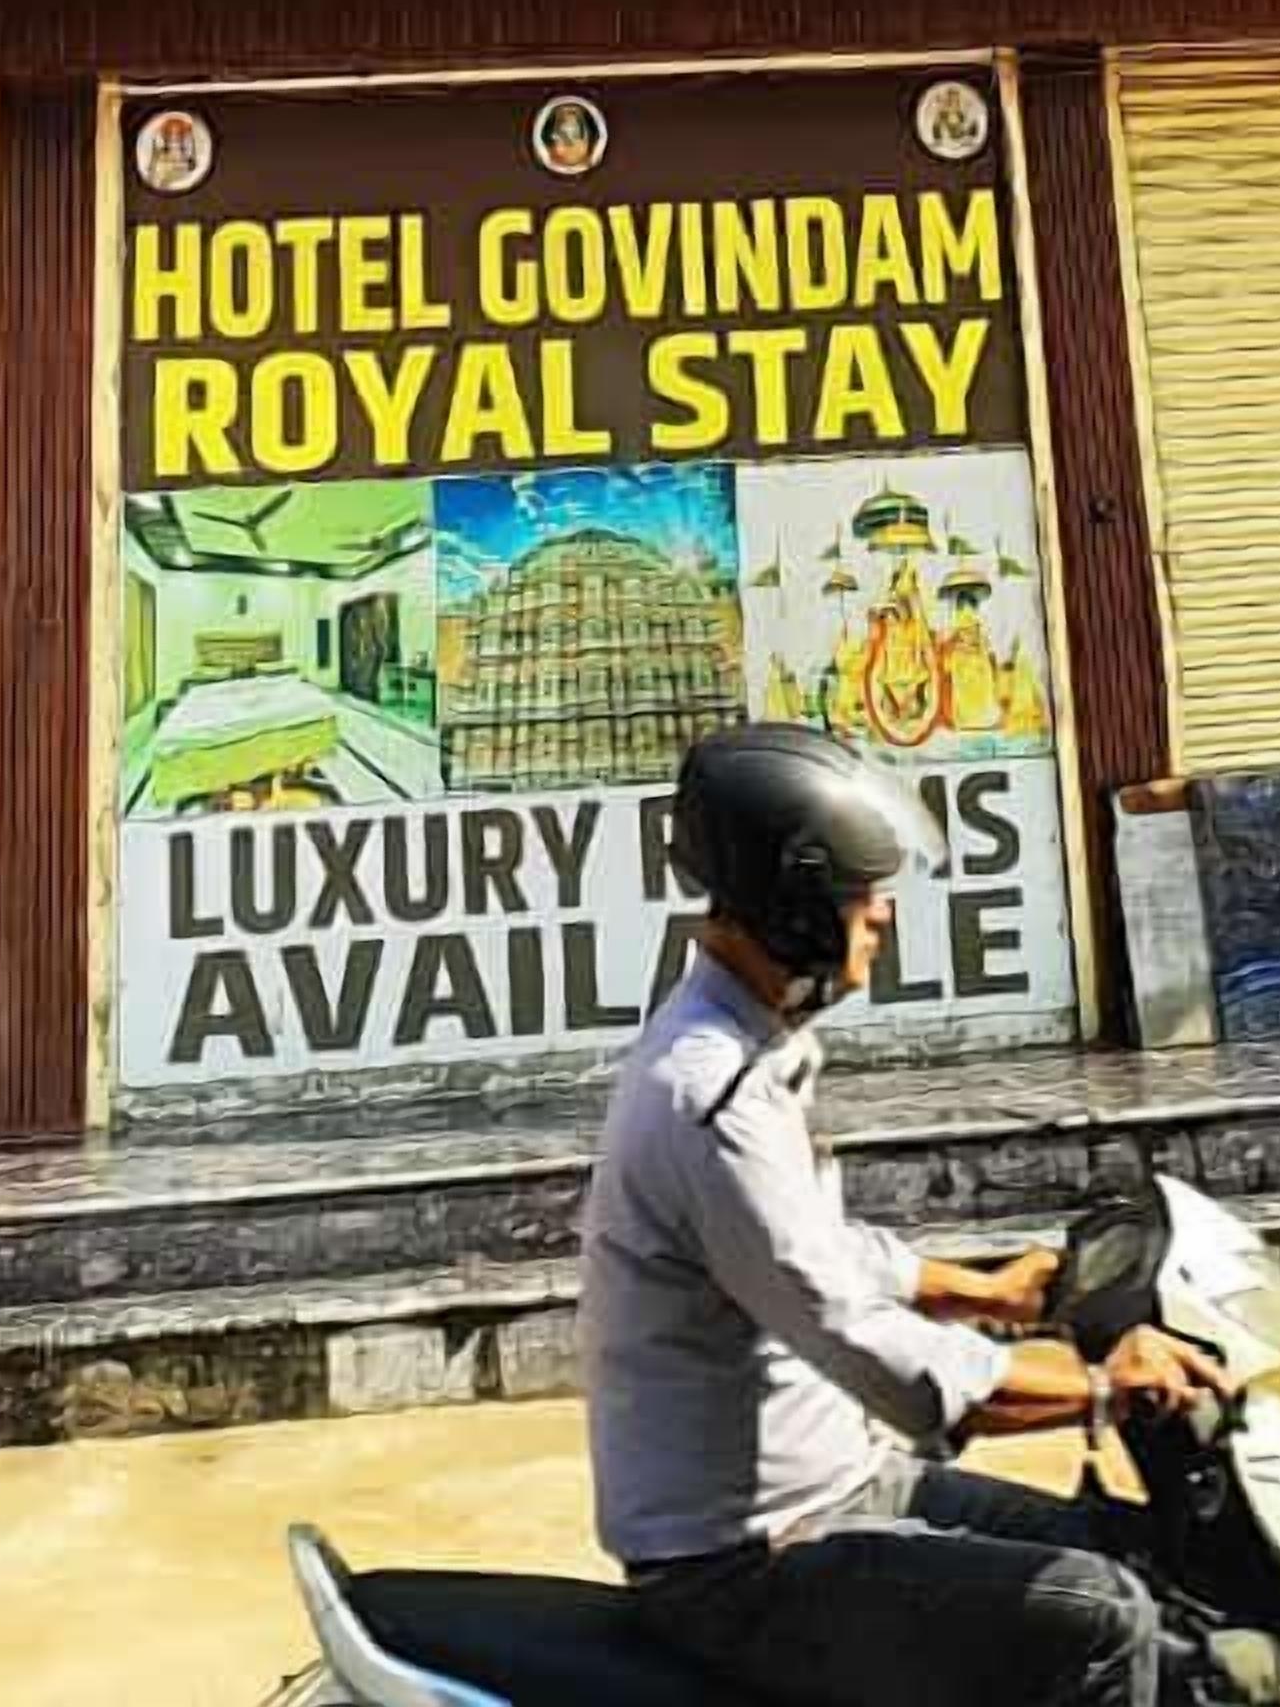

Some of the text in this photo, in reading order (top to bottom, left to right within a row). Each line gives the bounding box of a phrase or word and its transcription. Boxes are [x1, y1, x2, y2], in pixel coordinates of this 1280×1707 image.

[133, 188, 1003, 341] HOTEL GOVINDAM
[153, 318, 990, 476] ROYAL STAY
[166, 799, 600, 940] LUXURY
